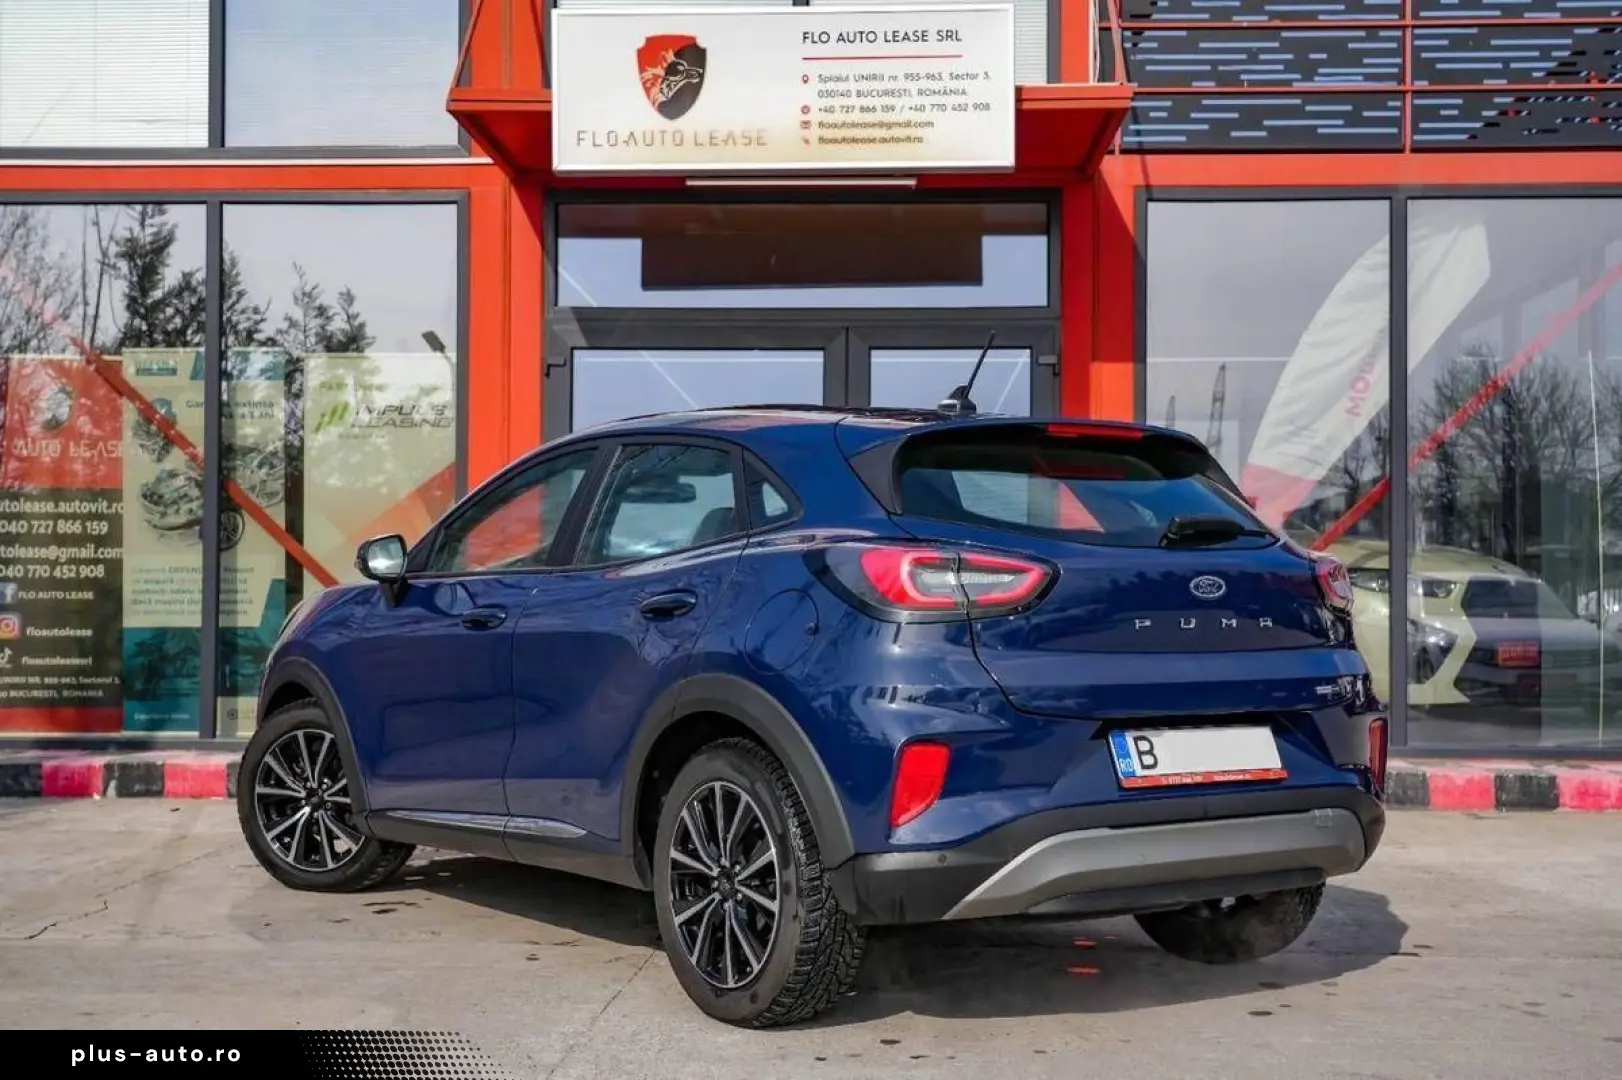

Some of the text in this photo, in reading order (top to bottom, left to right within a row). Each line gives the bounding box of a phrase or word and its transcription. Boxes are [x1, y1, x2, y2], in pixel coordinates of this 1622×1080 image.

[802, 29, 963, 44] FLO AUTO LEASE SRL
[817, 73, 850, 85] Splaiul
[853, 73, 885, 83] UNIRII
[949, 70, 980, 81] Sector
[817, 89, 853, 99] 030140
[917, 85, 968, 97] ROMÂNIA
[818, 105, 836, 114] +40
[840, 104, 856, 114] 727
[859, 103, 878, 114] 866
[881, 103, 897, 113] 159
[908, 103, 926, 113] +40
[930, 102, 948, 112] 770
[951, 102, 969, 112] 452
[973, 101, 992, 111] 908
[623, 130, 684, 147] AUTO
[693, 130, 768, 147] LEASE
[12, 438, 61, 457] AUTO
[31, 521, 53, 534] 727
[56, 520, 81, 534] 866
[85, 521, 109, 535] 159
[27, 565, 50, 578] 770
[53, 565, 76, 579] 452
[79, 564, 104, 578] 908
[19, 591, 93, 600] FLO AUTO LEASE
[1135, 617, 1273, 630] PUMA
[26, 627, 93, 637] floautolease
[1133, 735, 1158, 770] B
[1119, 757, 1134, 772] RO
